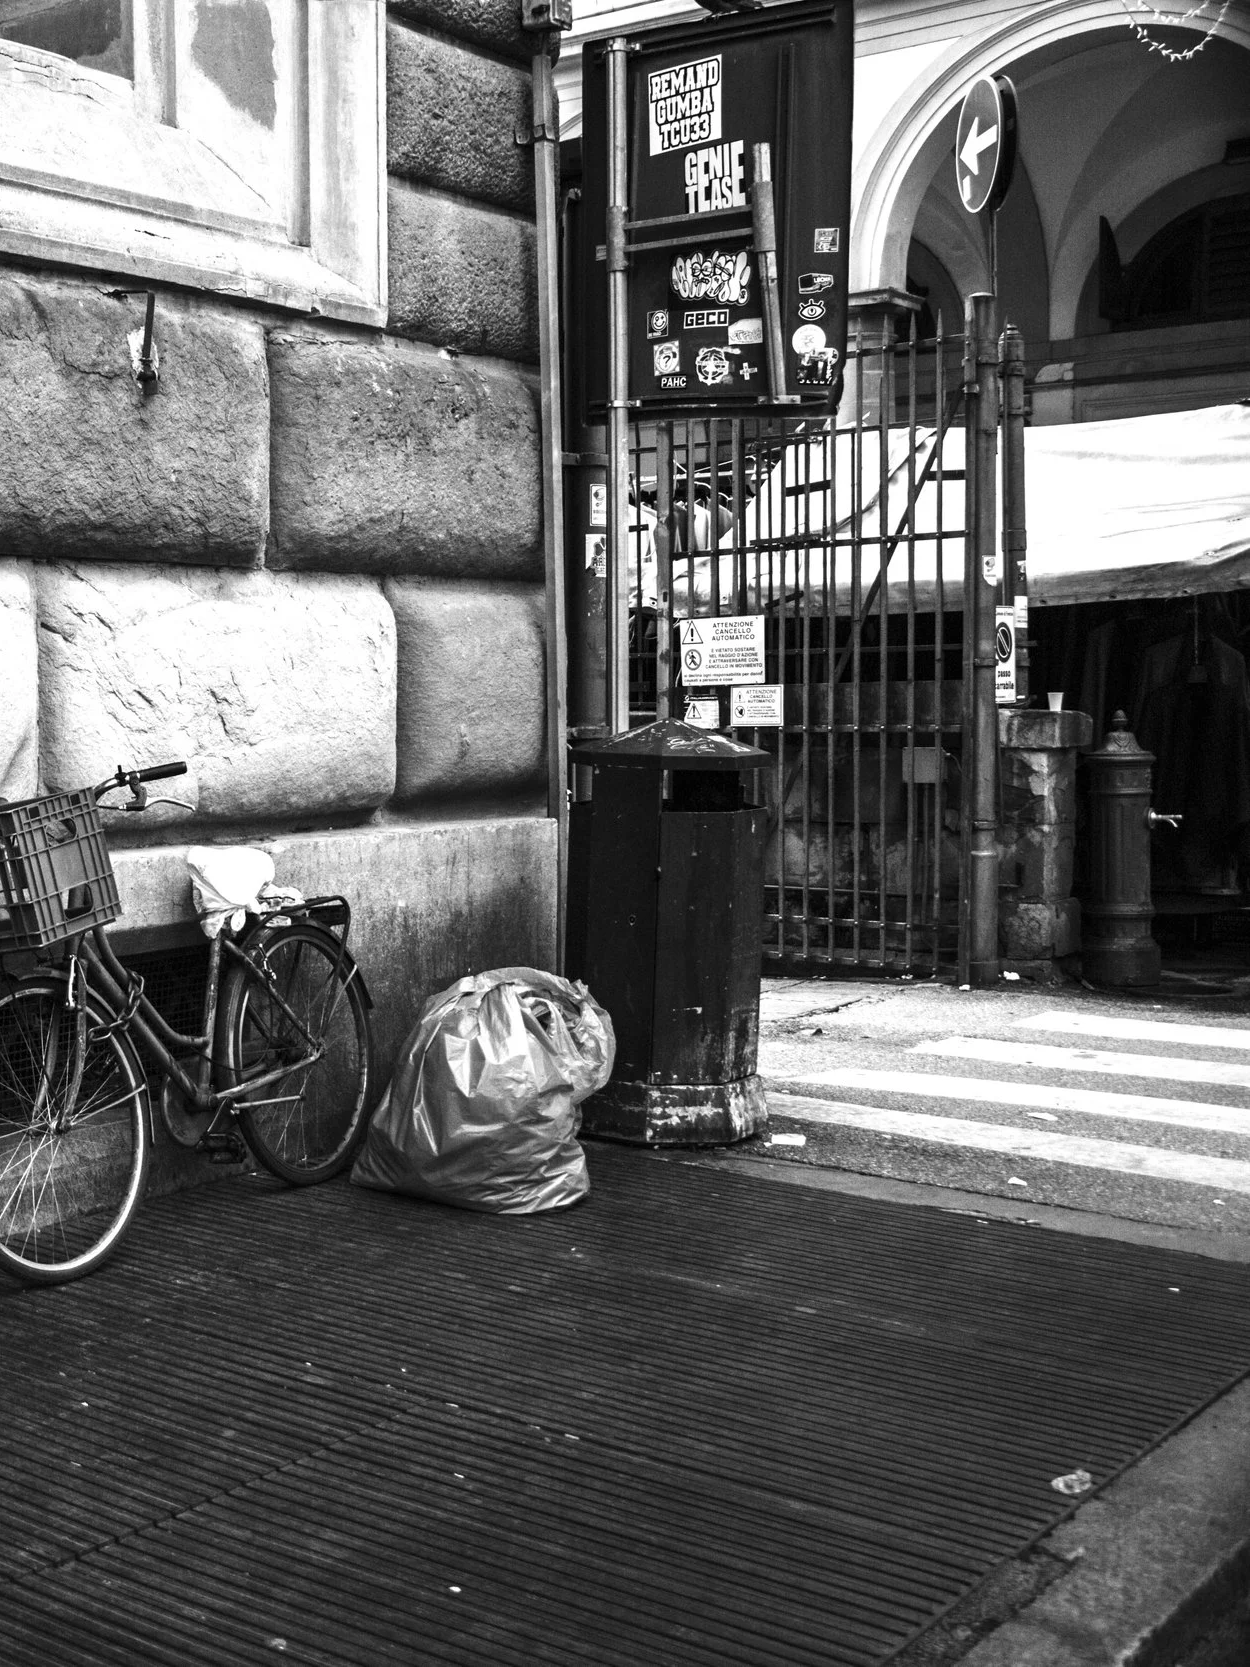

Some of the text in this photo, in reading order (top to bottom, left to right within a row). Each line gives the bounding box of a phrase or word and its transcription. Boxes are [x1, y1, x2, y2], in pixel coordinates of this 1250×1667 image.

[651, 58, 720, 102] REMAND
[656, 86, 714, 125] GUMBA
[660, 113, 711, 150] TCU33
[684, 140, 745, 187] GENIE
[685, 176, 746, 214] TEASE
[997, 670, 1011, 678] passo
